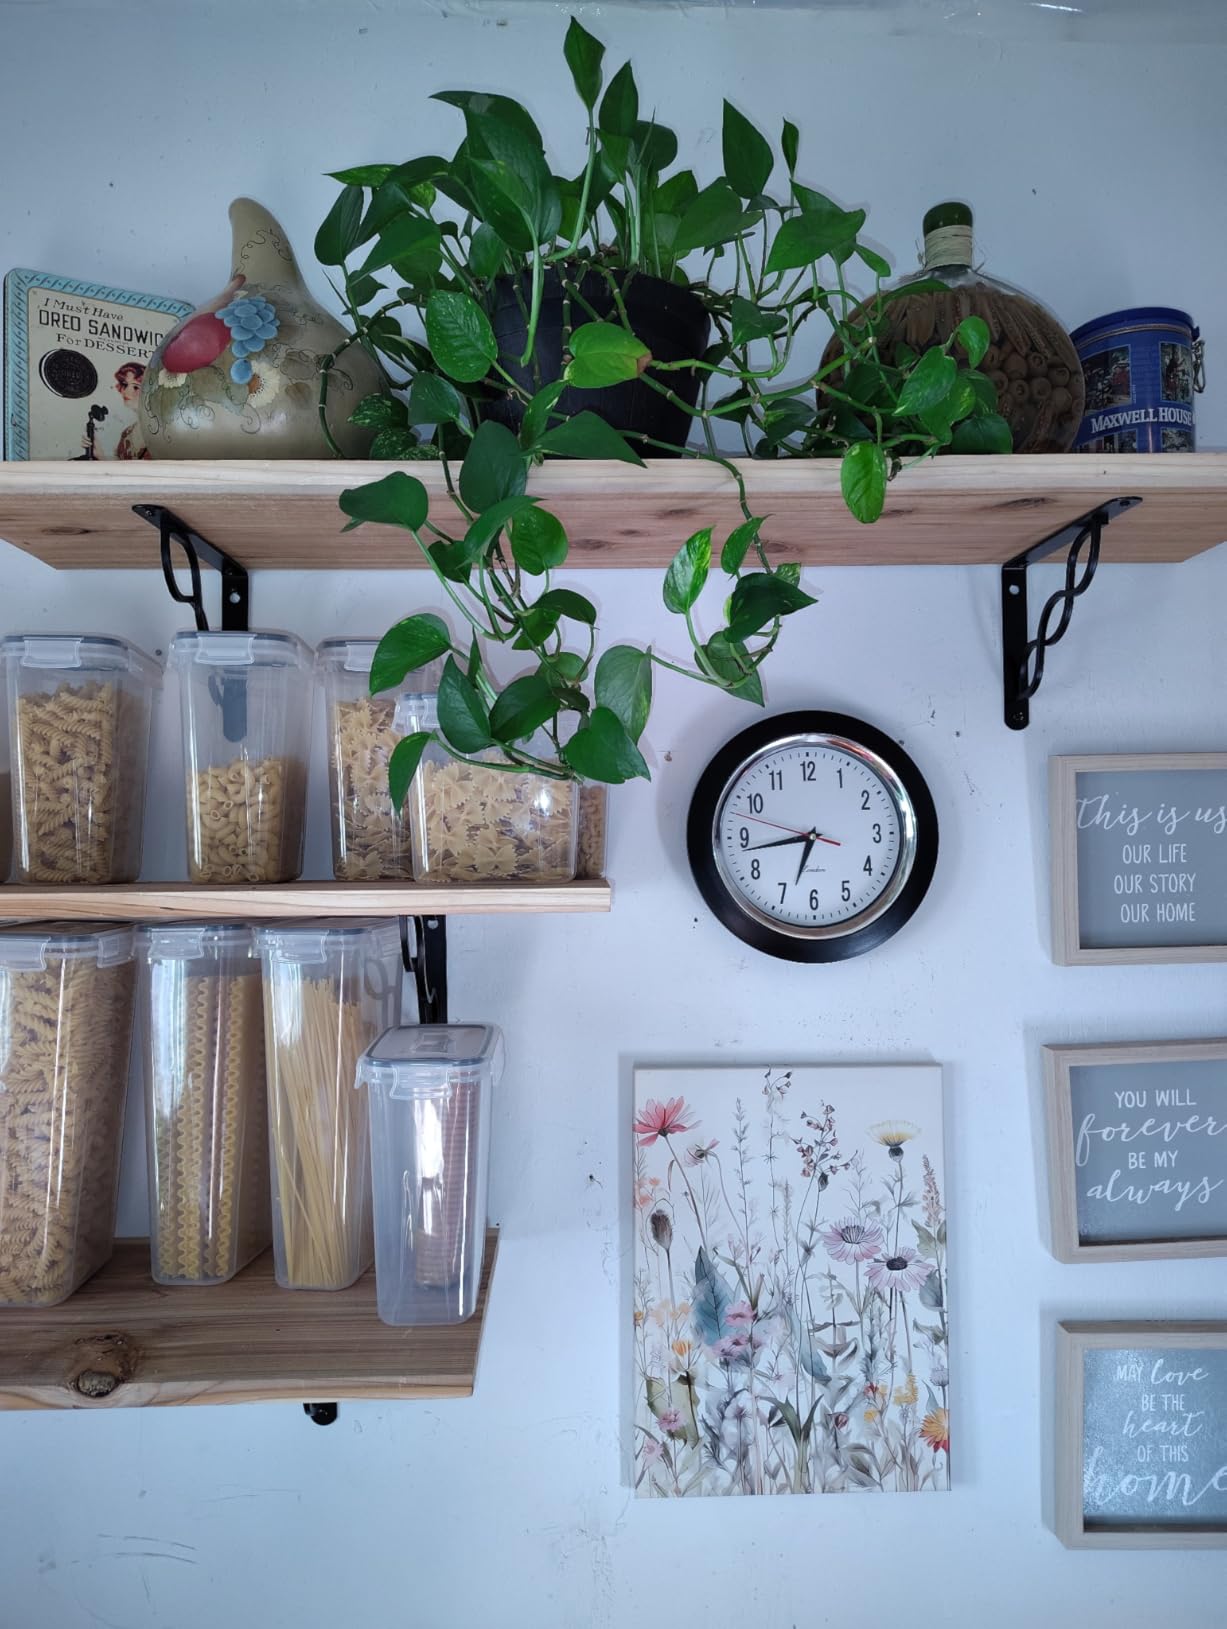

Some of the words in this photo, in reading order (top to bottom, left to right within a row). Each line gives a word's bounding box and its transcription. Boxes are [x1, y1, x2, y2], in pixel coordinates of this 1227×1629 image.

[44, 298, 50, 306] I
[53, 299, 90, 315] Must
[92, 307, 124, 321] Have
[39, 309, 81, 332] OREO
[56, 333, 82, 346] For
[1090, 408, 1158, 434] MAXWELL
[1158, 406, 1192, 426] HOUSE
[768, 769, 784, 790] 11
[800, 761, 817, 782] 12
[836, 768, 843, 788] 1
[747, 793, 764, 814] 10
[861, 790, 871, 811] 2
[1076, 794, 1153, 836] This
[1157, 804, 1191, 836] is
[1195, 806, 1227, 835] us
[740, 827, 750, 849] 9
[872, 824, 882, 844] 3
[1122, 844, 1152, 864] OUR
[1158, 843, 1188, 864] LIFE
[750, 859, 760, 880] 8
[863, 855, 872, 876] 4
[778, 882, 788, 904] 7
[841, 880, 851, 902] 5
[1114, 873, 1144, 895] OUR
[1149, 872, 1197, 894] STORY
[809, 889, 818, 911] 6
[1120, 903, 1150, 924] OUR
[1156, 902, 1196, 923] HOME
[1114, 1090, 1147, 1109] YOU
[1156, 1088, 1198, 1107] WILL
[1076, 1112, 1227, 1168] forever
[1128, 1152, 1147, 1170] BE
[1154, 1150, 1179, 1168] MY
[1086, 1169, 1225, 1212] always
[1116, 1364, 1144, 1382] MAY
[1150, 1358, 1209, 1386] love
[1141, 1394, 1156, 1412] BE
[1161, 1393, 1186, 1412] THE
[1122, 1410, 1205, 1440] heart
[1137, 1444, 1154, 1462] OF
[1159, 1444, 1190, 1462] THIS
